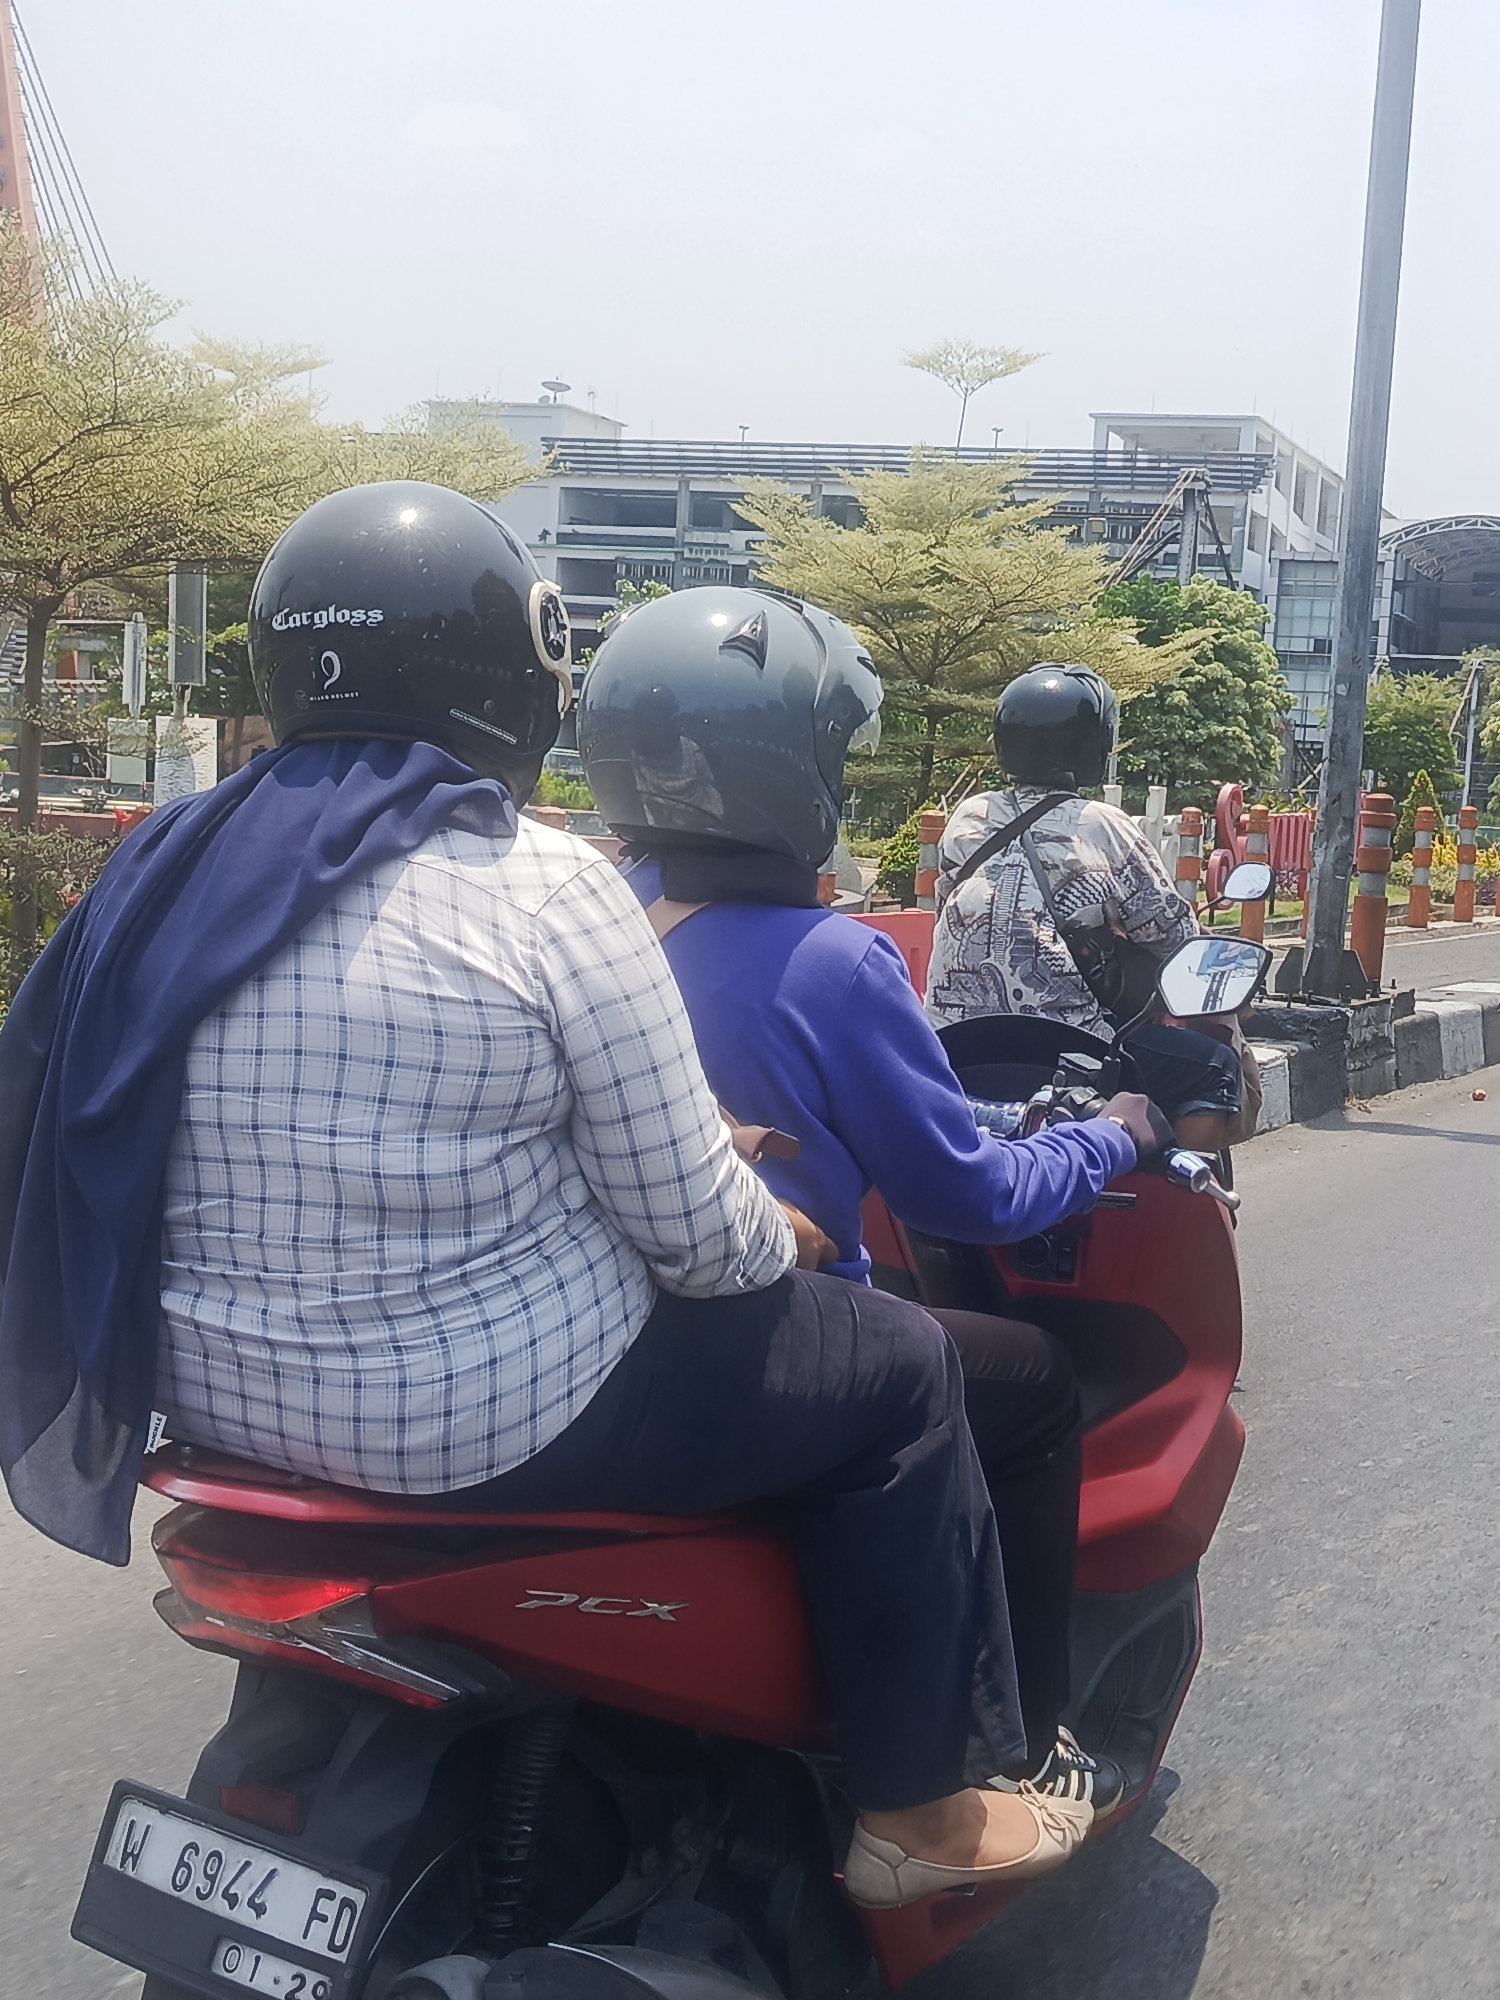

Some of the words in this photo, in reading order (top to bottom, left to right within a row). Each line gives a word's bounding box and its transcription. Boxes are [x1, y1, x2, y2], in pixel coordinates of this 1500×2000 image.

[271, 603, 384, 631] Cargloss
[515, 1589, 690, 1621] PCX
[119, 1818, 152, 1873] W
[170, 1841, 279, 1920] 6944
[302, 1887, 358, 1954] FD
